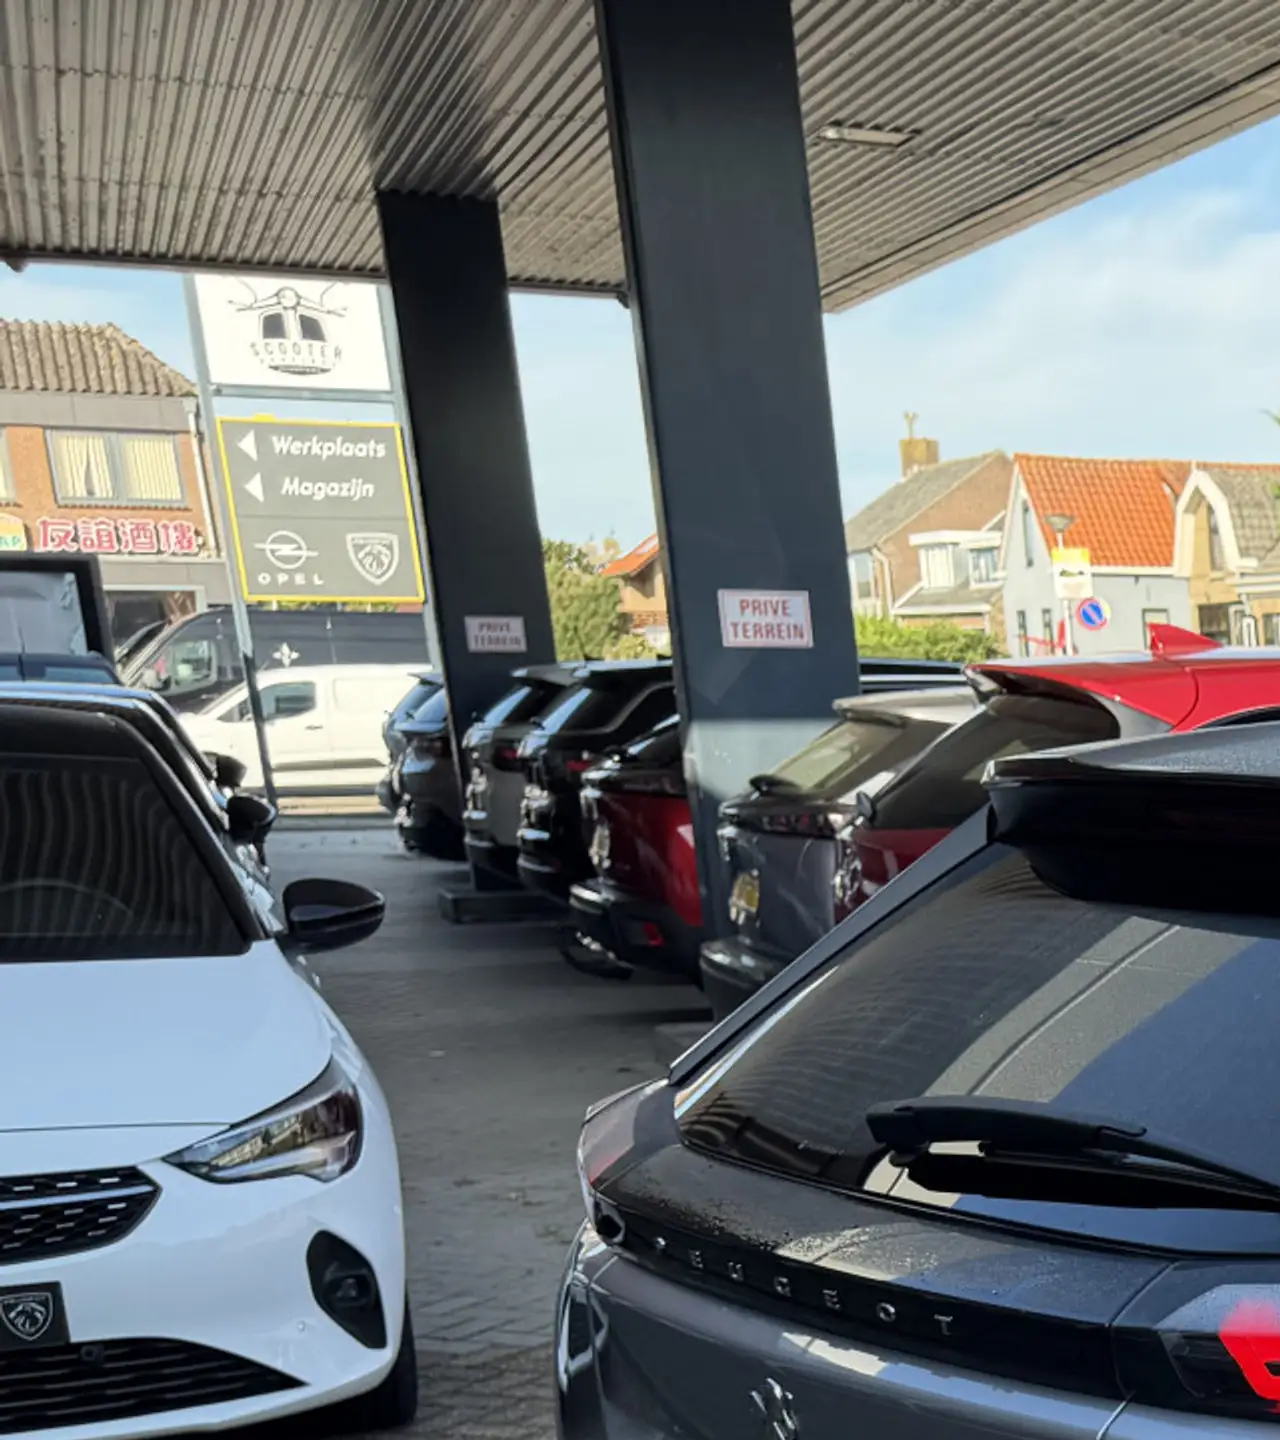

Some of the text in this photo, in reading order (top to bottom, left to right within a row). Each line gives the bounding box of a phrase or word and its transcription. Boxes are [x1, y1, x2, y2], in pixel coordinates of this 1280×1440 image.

[271, 435, 386, 462] Werkplaats
[280, 477, 375, 501] Magazijn
[257, 572, 324, 586] OPEL
[738, 598, 792, 617] PRIVE
[730, 621, 805, 640] TERREIN
[653, 1236, 954, 1336] PEUGEOT
